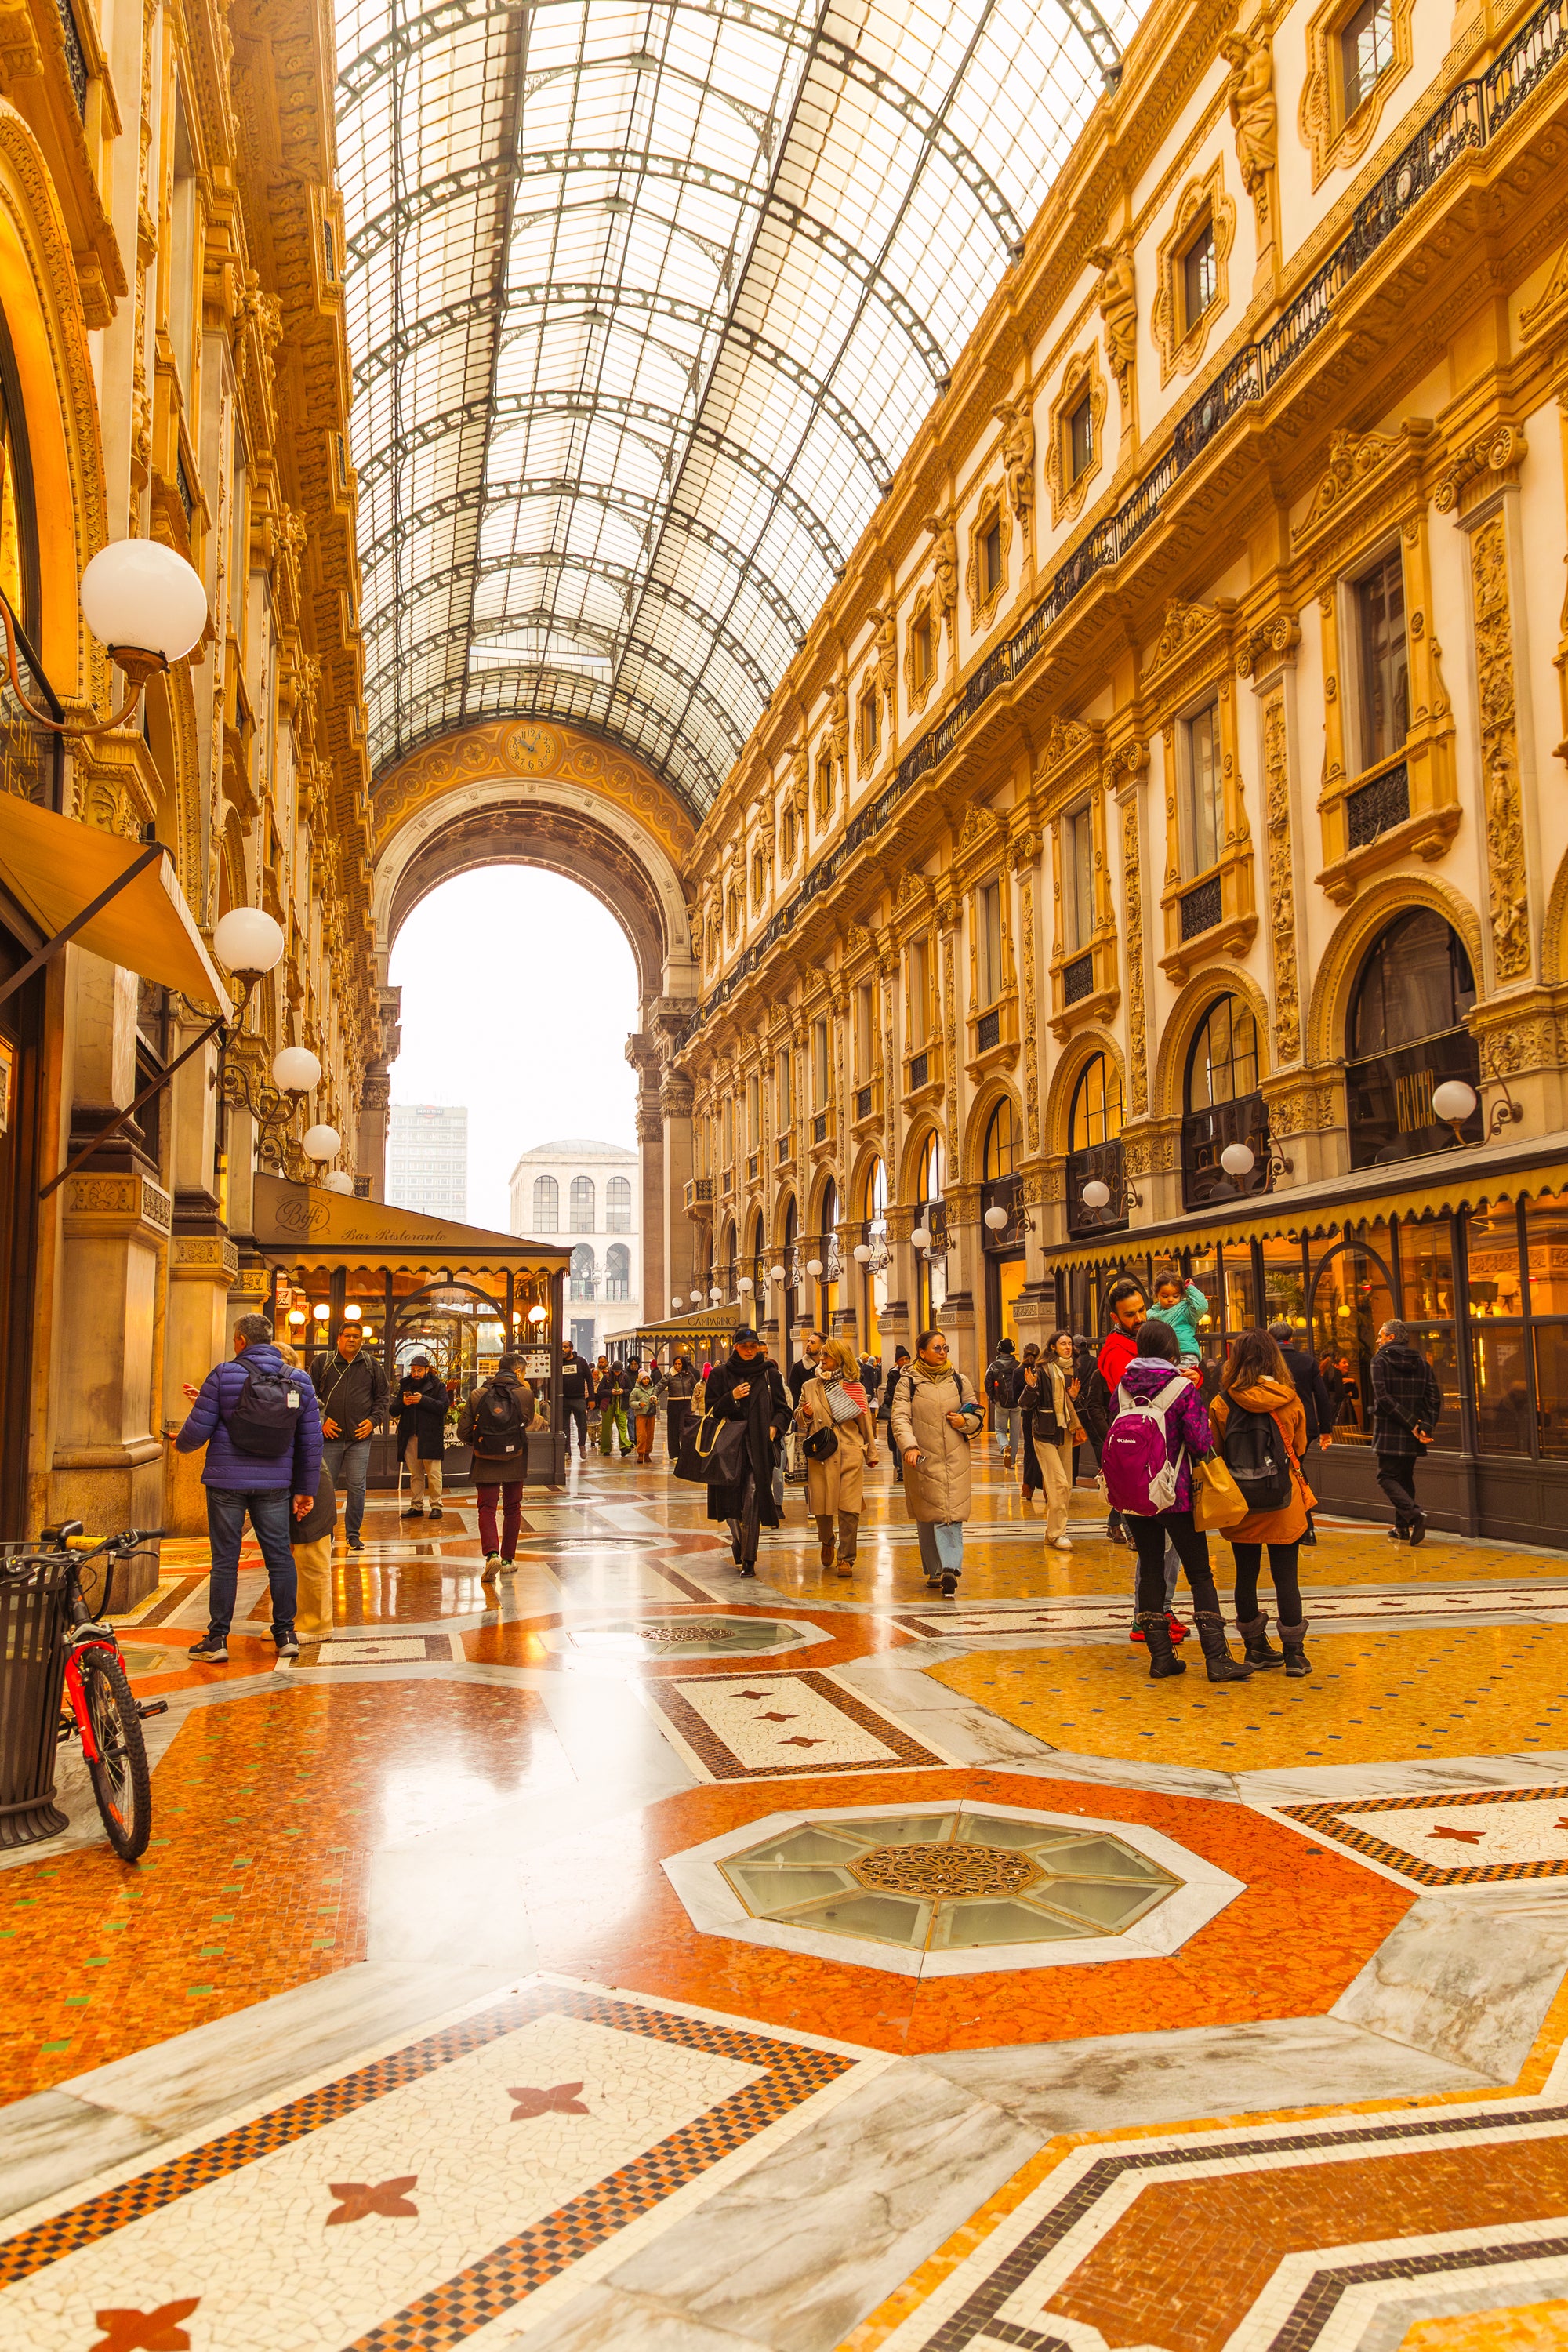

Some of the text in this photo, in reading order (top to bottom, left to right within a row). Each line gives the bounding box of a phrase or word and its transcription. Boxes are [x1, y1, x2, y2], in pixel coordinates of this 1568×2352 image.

[528, 728, 535, 737] 12
[546, 745, 550, 753] 3
[514, 751, 520, 760] 8
[520, 758, 525, 767] 7
[538, 758, 543, 768] 5
[1396, 1068, 1436, 1134] CRACCO
[1198, 1132, 1264, 1171] GUI
[283, 1202, 324, 1231] Biffi
[341, 1229, 370, 1240] Bar
[375, 1229, 448, 1241] Ristorante
[931, 1232, 945, 1247] LEX
[688, 1317, 737, 1326] CAMPARINO
